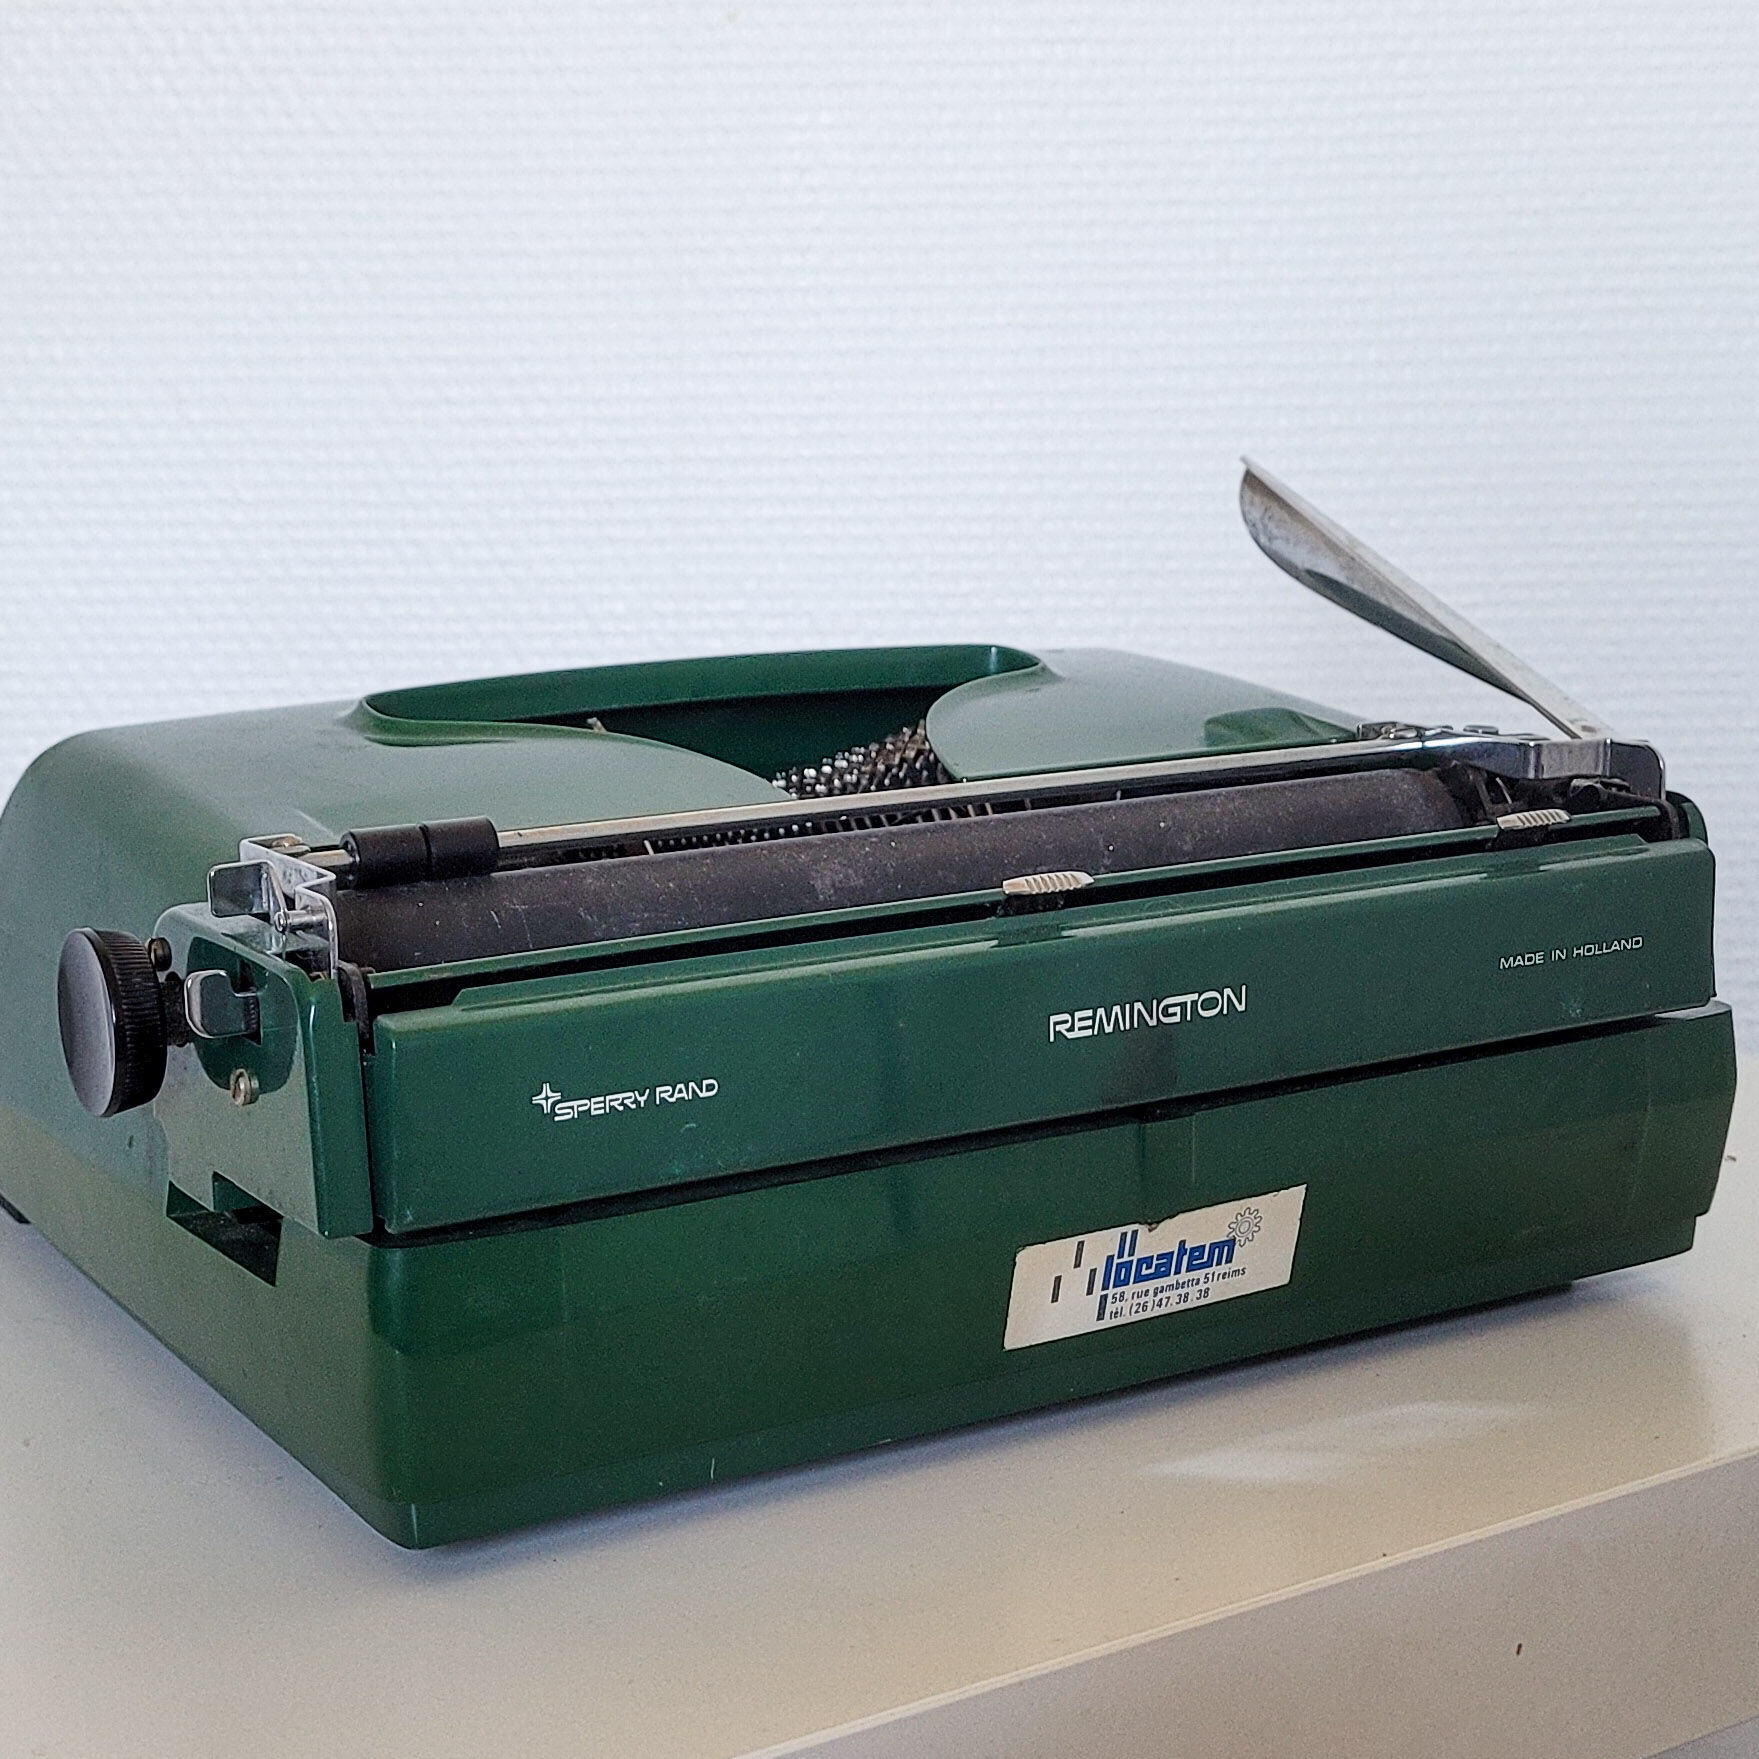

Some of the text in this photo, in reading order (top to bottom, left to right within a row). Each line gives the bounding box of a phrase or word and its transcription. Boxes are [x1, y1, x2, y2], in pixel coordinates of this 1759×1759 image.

[1499, 936, 1643, 970] MADE IN HOLLAND
[1049, 984, 1247, 1043] REMINGTON
[553, 1078, 719, 1122] SPERRY RAND
[1101, 1235, 1237, 1291] locatem
[1131, 1288, 1150, 1300] rue
[1153, 1278, 1201, 1298] gambetta
